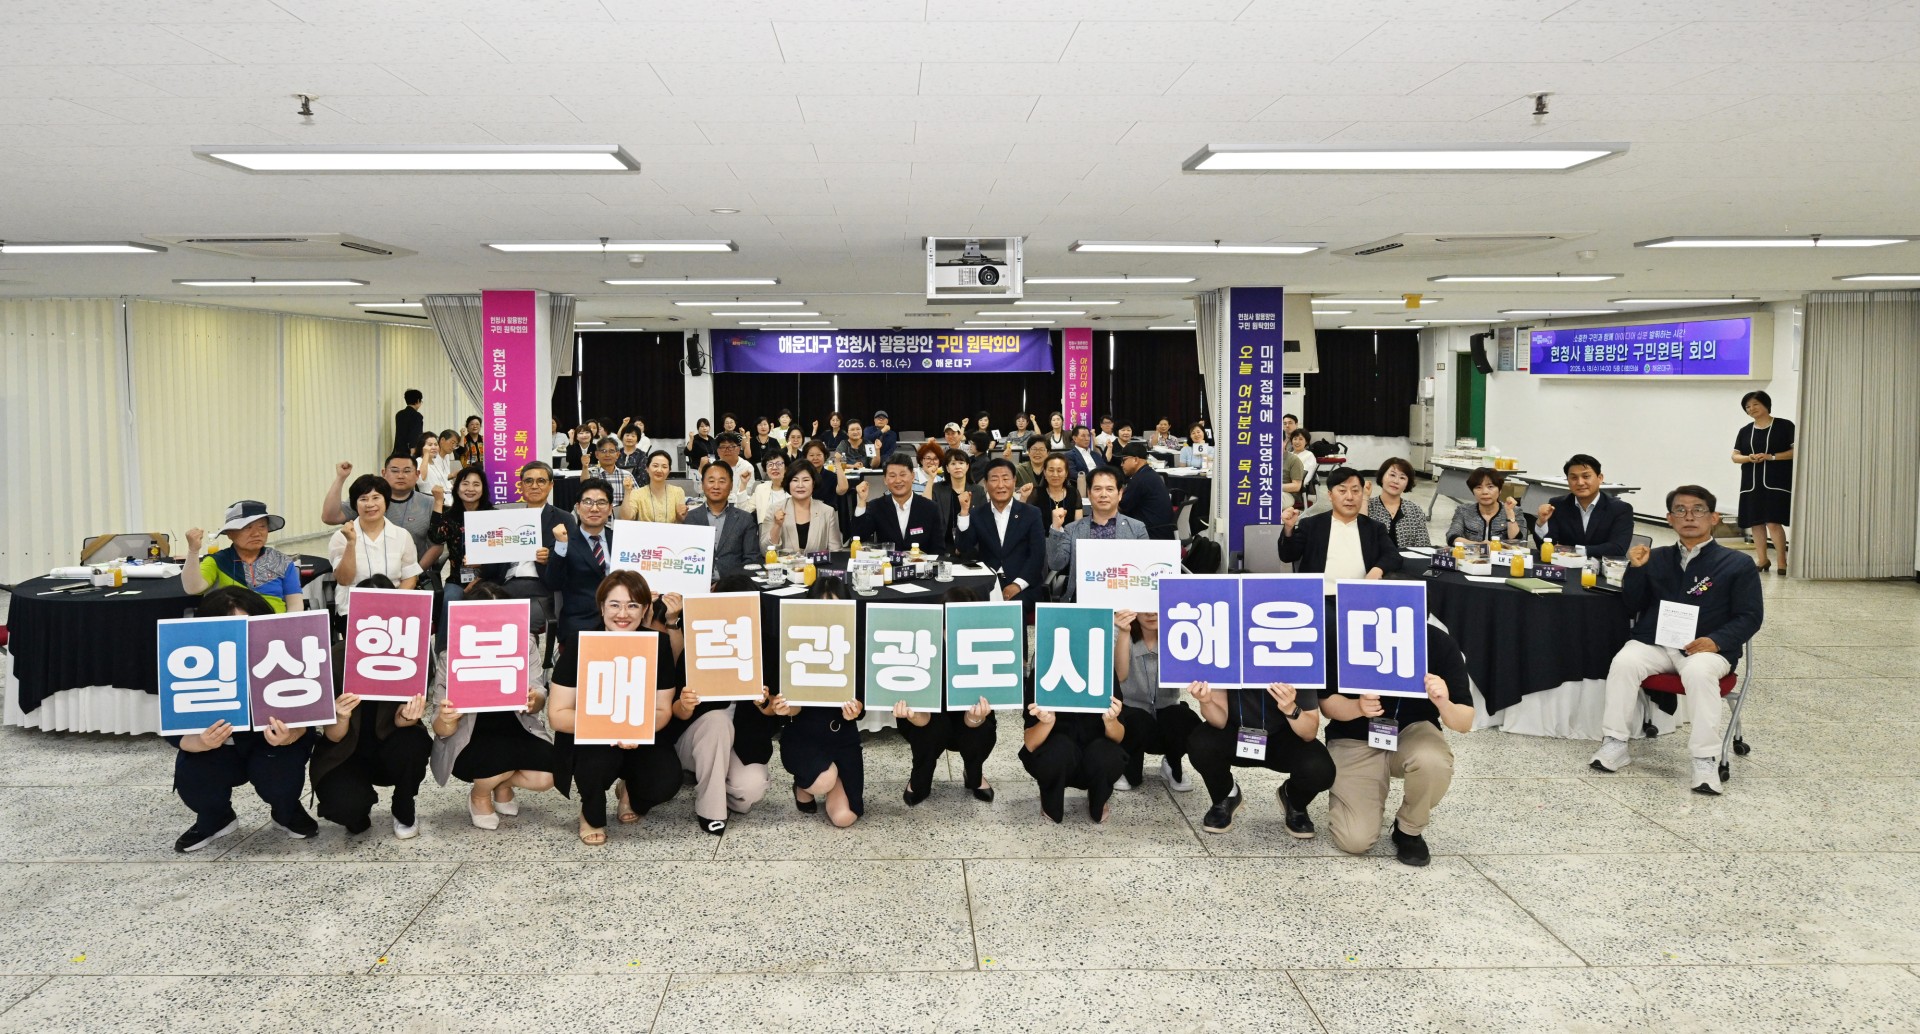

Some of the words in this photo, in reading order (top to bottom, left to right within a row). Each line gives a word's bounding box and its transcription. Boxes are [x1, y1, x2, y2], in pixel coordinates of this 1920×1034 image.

[492, 348, 507, 392] 현청사
[778, 335, 832, 354] 해운대구
[836, 335, 876, 354] 현청사
[880, 335, 933, 354] 활용방안
[936, 335, 963, 354] 구민
[967, 335, 1020, 354] 원탁회의
[838, 358, 866, 368] 2025.
[869, 358, 878, 368] 6.
[881, 358, 912, 369] 18.(수)
[936, 358, 972, 368] 해운대구
[1238, 345, 1254, 375] 오늘
[1260, 345, 1274, 374] 미래
[1551, 345, 1580, 362] 현청사
[1584, 344, 1628, 362] 활용방안
[1633, 341, 1684, 361] 구민원탁
[1689, 340, 1716, 360] 회의
[1237, 384, 1252, 445] 여러분의
[1260, 380, 1274, 424] 정책에
[492, 402, 508, 461] 활용방안
[514, 430, 528, 459] 폭싹
[1198, 444, 1204, 452] 6
[1236, 459, 1252, 506] 목소리
[1258, 433, 1274, 524] 반영하겠습니
[520, 537, 536, 546] 도시
[620, 551, 641, 563] 일상
[641, 548, 663, 560] 행복
[640, 560, 662, 572] 매력
[662, 558, 684, 570] 관광
[683, 563, 705, 576] 도시
[1085, 570, 1106, 582] 일상
[1106, 566, 1128, 579] 행복
[1107, 578, 1128, 590] 매력
[1129, 575, 1151, 587] 관광
[355, 615, 421, 681] 행
[451, 623, 525, 695] 복
[691, 616, 754, 682] 력
[786, 624, 850, 688] 관
[952, 628, 1018, 688] 도
[1168, 601, 1230, 668] 해
[1248, 601, 1318, 667] 운
[1347, 606, 1415, 678] 대
[167, 641, 241, 714] 일
[252, 636, 327, 708] 상
[871, 630, 937, 692] 광
[1040, 627, 1105, 697] 시
[586, 656, 646, 727] 매
